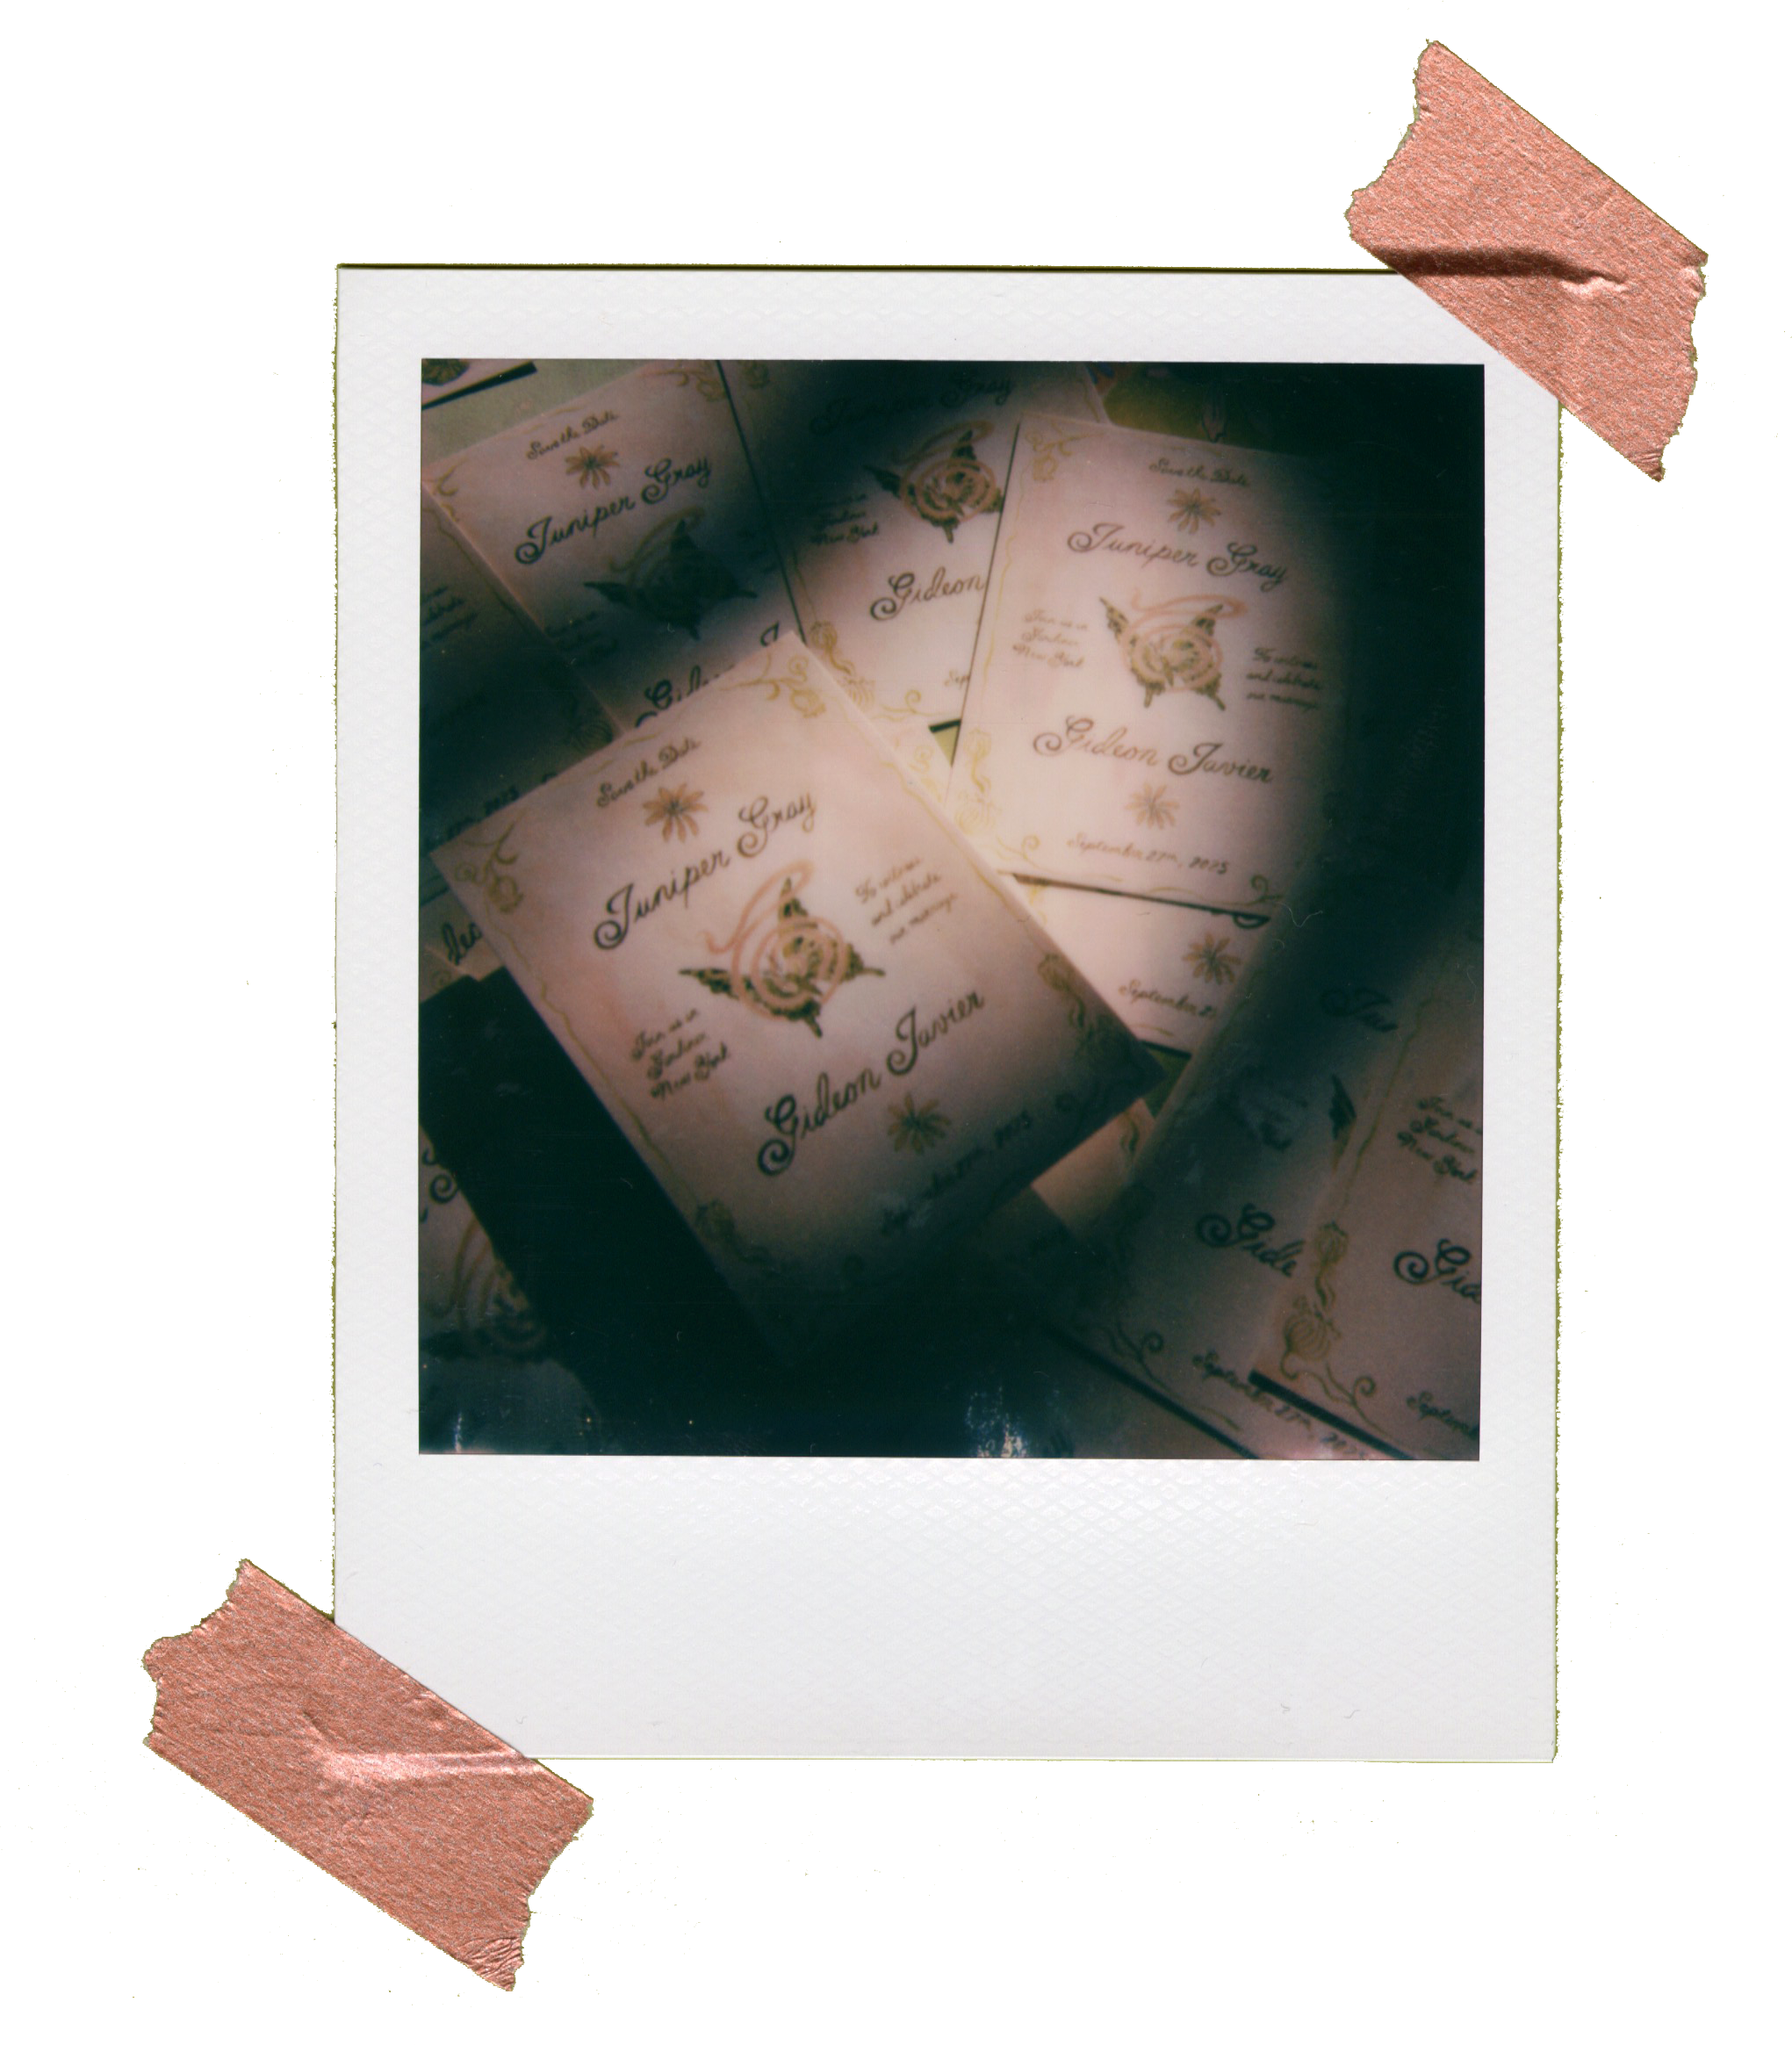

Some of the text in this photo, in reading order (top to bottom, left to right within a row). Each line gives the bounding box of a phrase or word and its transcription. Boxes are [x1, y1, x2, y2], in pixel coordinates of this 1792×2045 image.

[515, 456, 711, 565] Juniper Gray
[1067, 522, 1289, 593] Juniper Gray
[870, 566, 986, 622] Gideon
[1033, 715, 1273, 783] Gideon Javier
[596, 782, 634, 809] Save
[634, 760, 658, 784] the
[594, 791, 817, 950] Juniper Gray
[1189, 855, 1229, 875] 2025
[757, 990, 984, 1177] Gideon Javier
